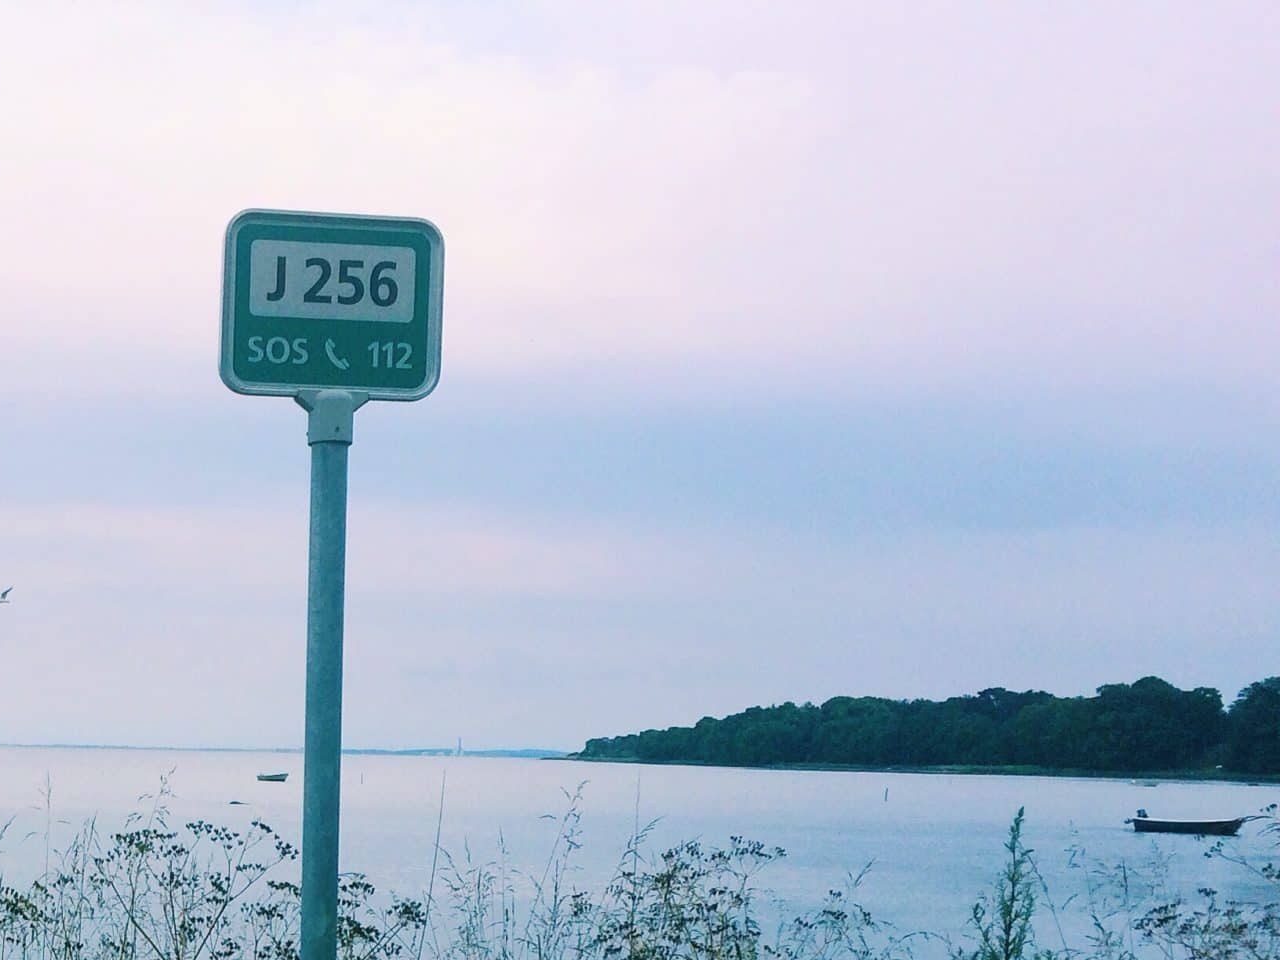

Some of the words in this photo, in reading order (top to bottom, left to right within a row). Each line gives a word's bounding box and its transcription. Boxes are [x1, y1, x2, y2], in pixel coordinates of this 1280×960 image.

[266, 256, 287, 302] J
[303, 257, 399, 307] 256
[247, 336, 309, 365] SOS
[368, 341, 413, 369] 112
